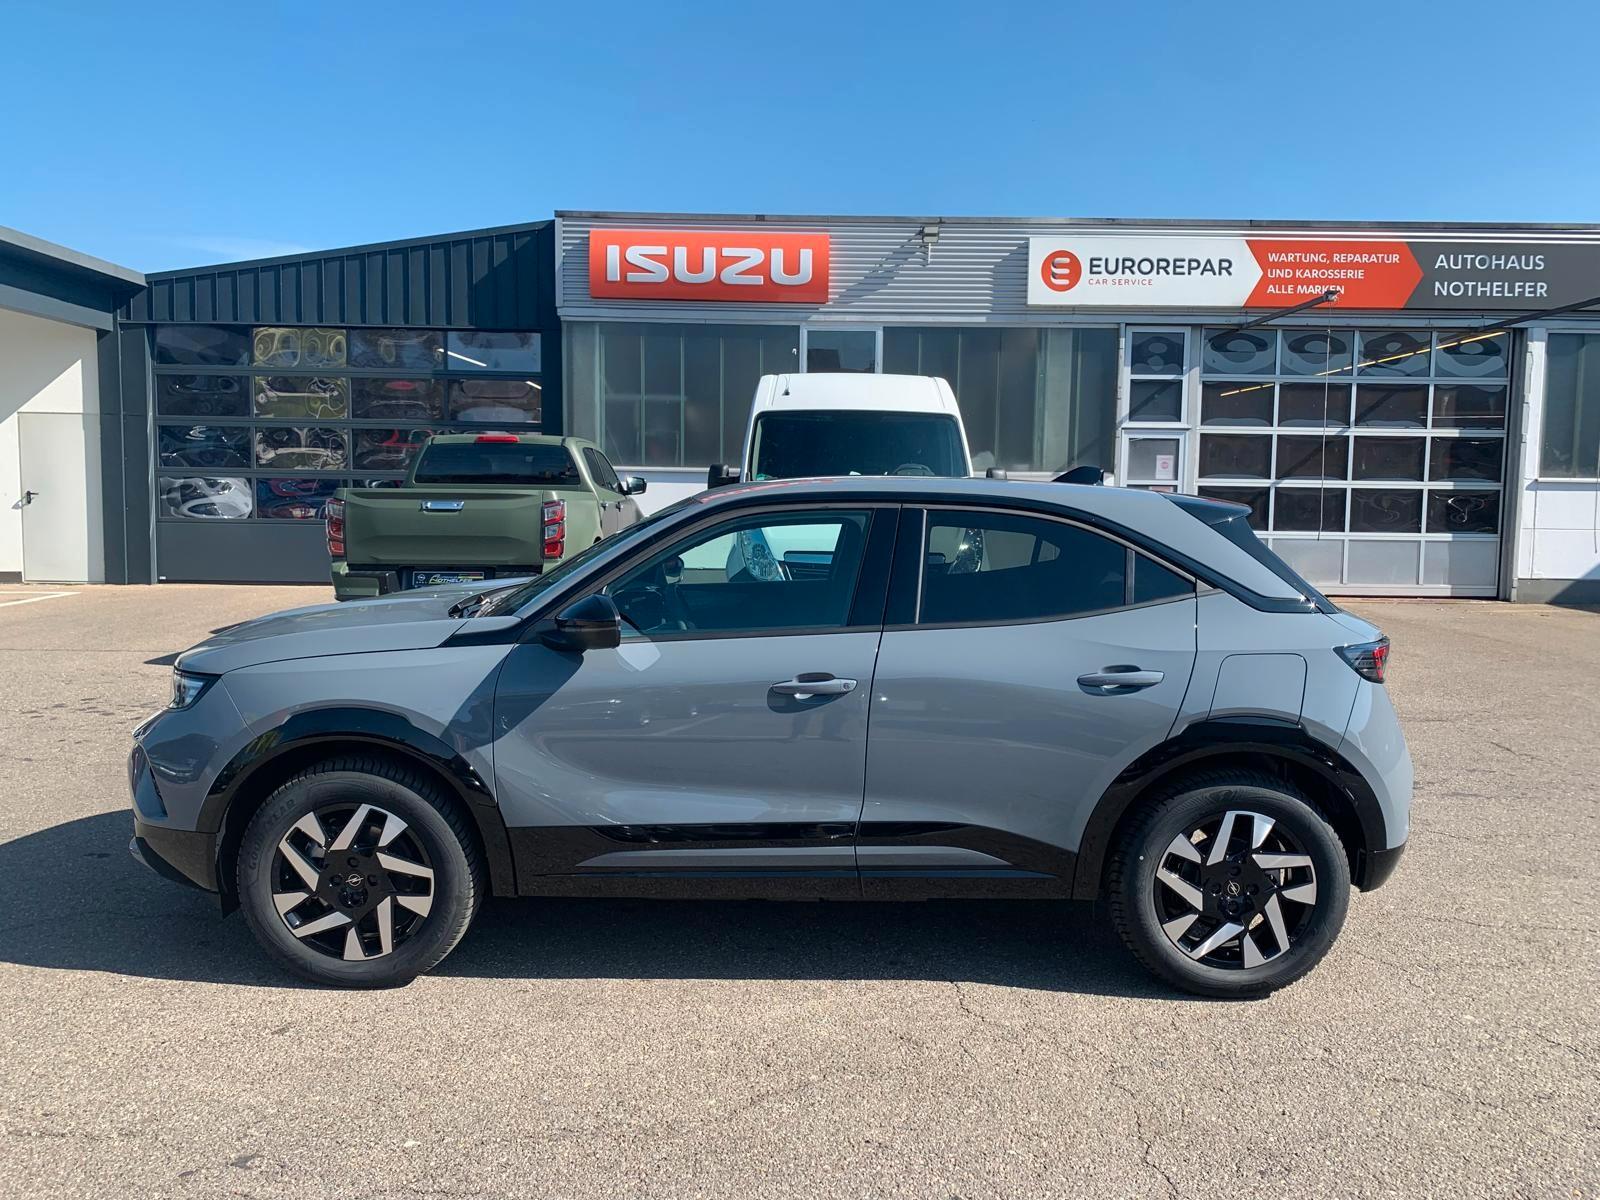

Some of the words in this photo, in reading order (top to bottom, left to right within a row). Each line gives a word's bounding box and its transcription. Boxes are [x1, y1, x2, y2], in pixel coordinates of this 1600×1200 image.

[606, 244, 813, 285] ISUZU
[1268, 252, 1330, 264] WARTUNG,
[1333, 253, 1400, 264] REPARATUR
[1434, 254, 1545, 270] AUTOHAUS
[1089, 257, 1233, 276] EUROREPAR
[1267, 269, 1293, 278] UND
[1295, 269, 1365, 279] KAROSSERIE
[1088, 278, 1108, 286] CAR
[1111, 278, 1153, 286] SERVICE
[1267, 284, 1295, 294] ALLE
[1434, 281, 1548, 297] NOTHELFER
